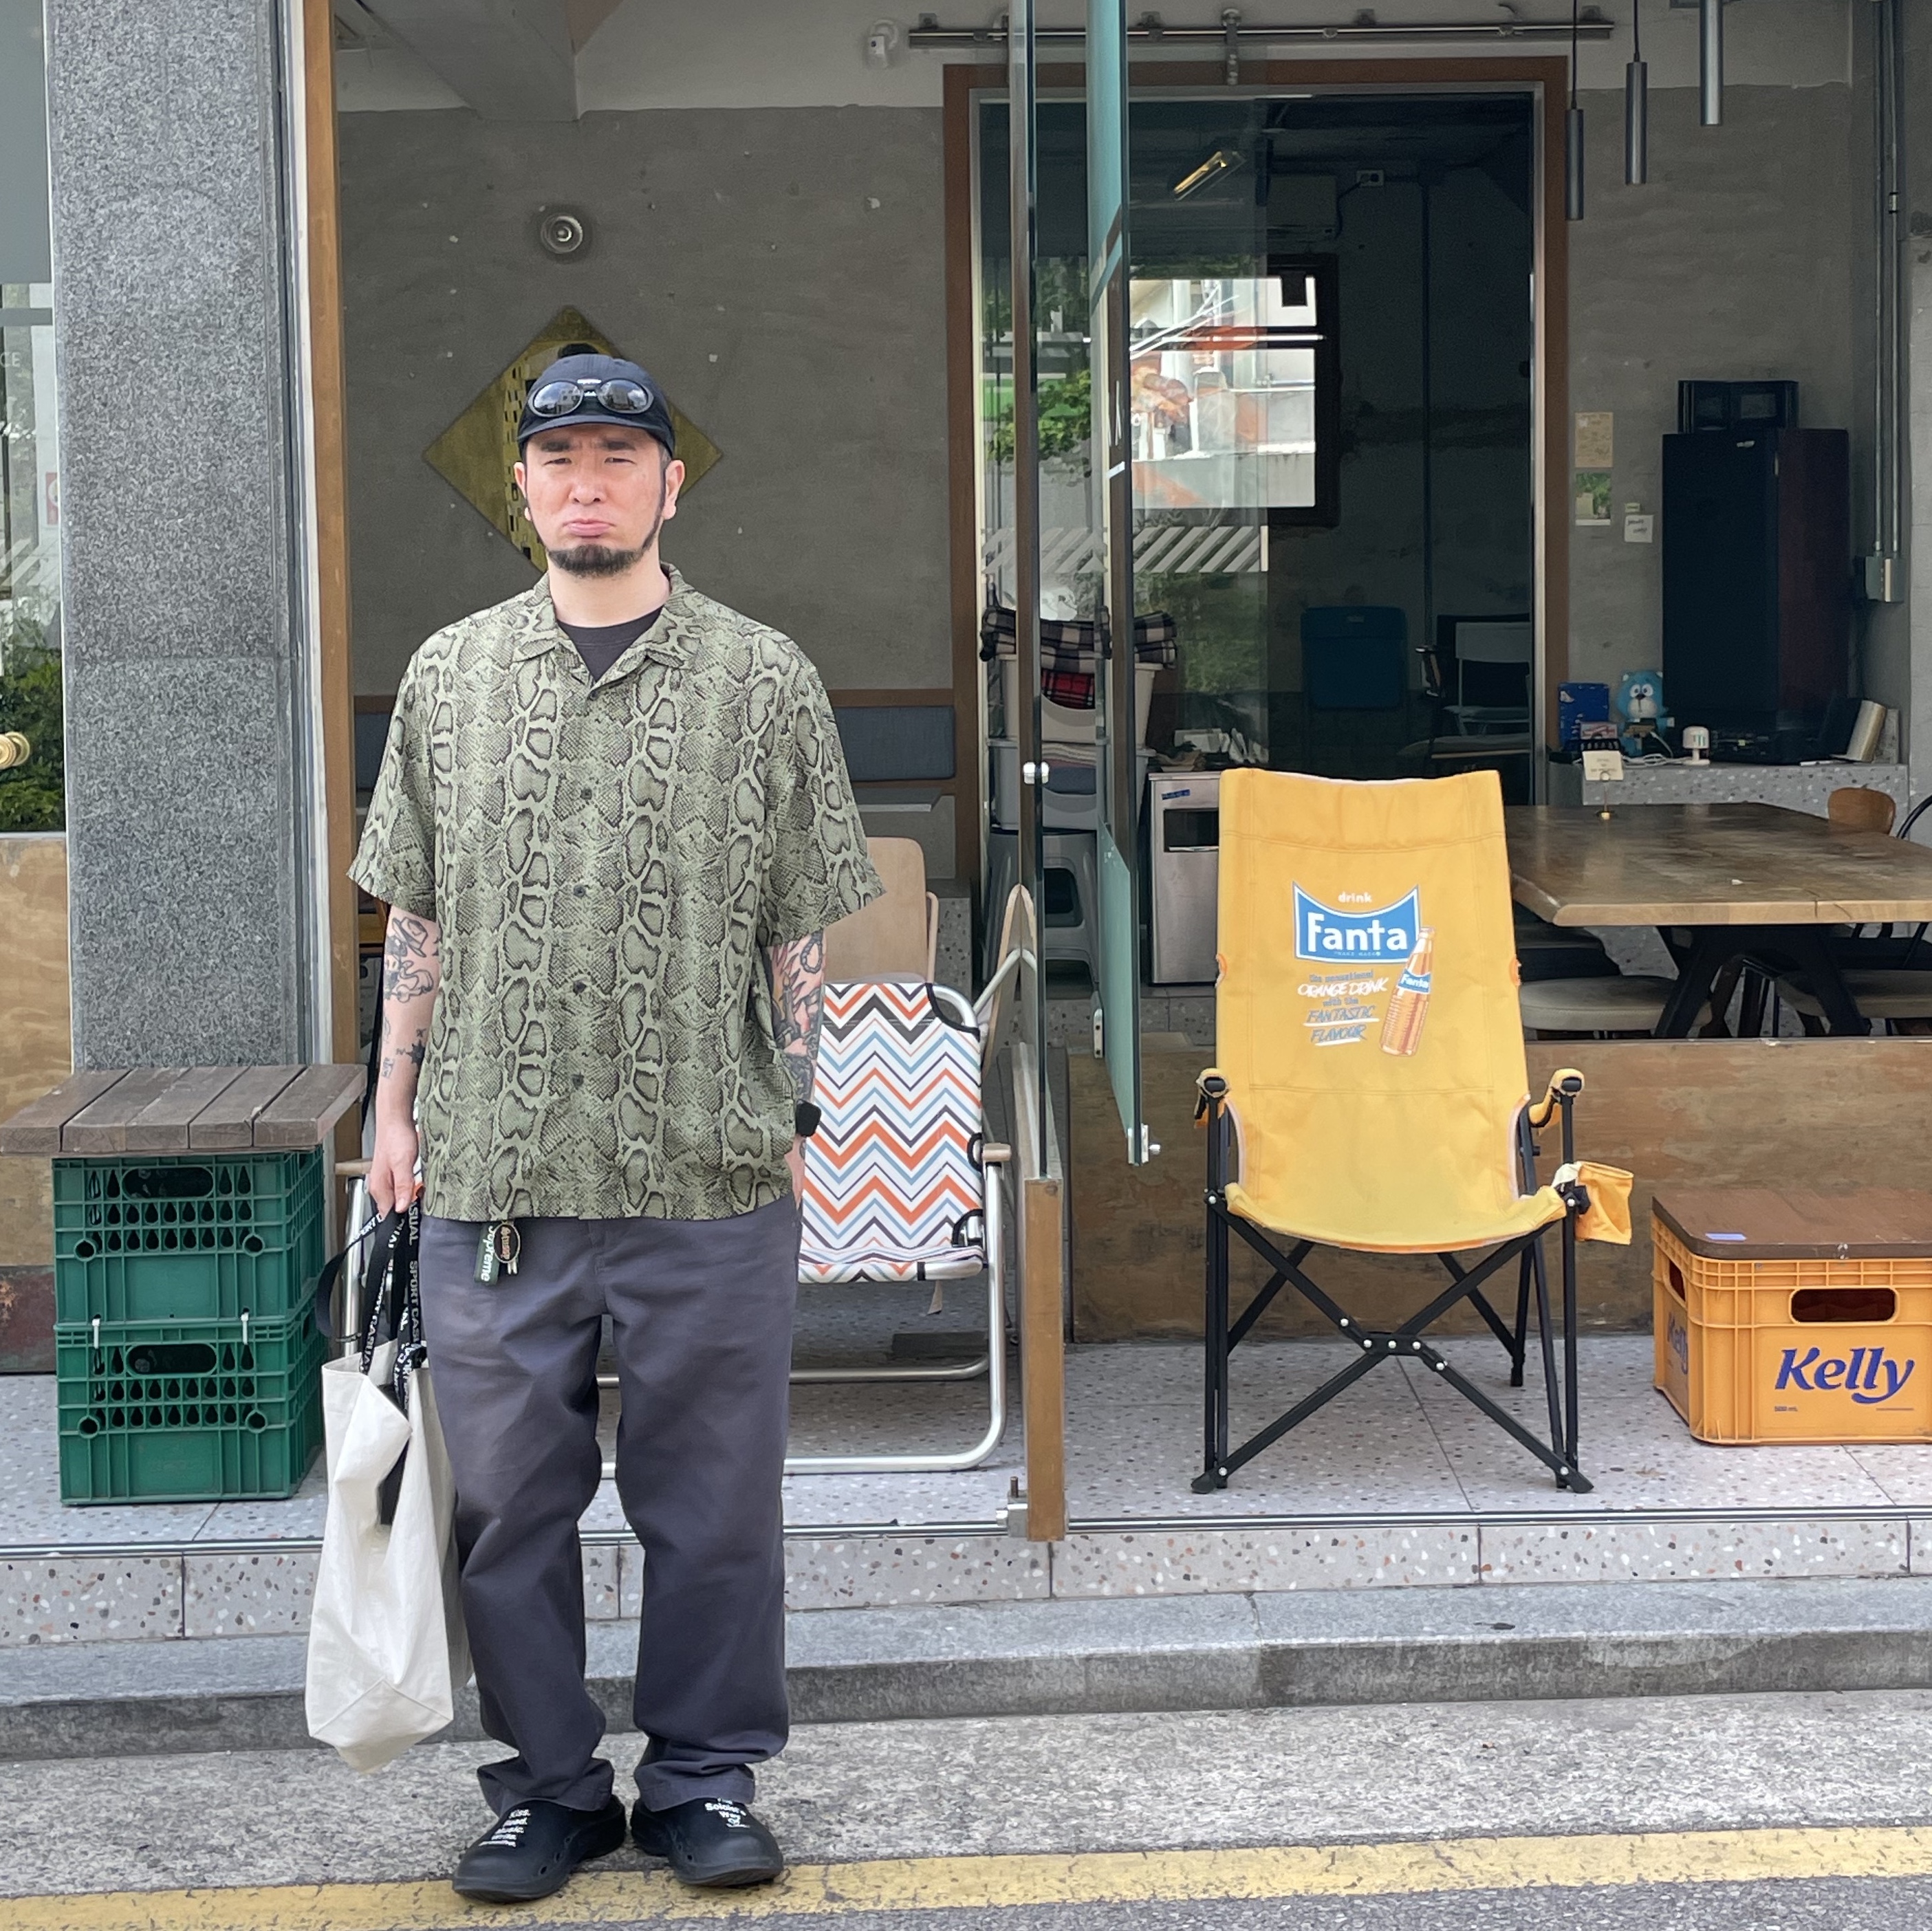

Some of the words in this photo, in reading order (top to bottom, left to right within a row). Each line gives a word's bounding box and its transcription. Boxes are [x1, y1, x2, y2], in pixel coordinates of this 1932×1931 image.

[1338, 891, 1372, 903] drink
[1307, 912, 1407, 952] Fanta
[1297, 981, 1349, 998] ORANGE
[1349, 977, 1389, 996] DRINK
[1401, 974, 1429, 988] Fanta
[481, 1225, 495, 1281] Supreme
[410, 1261, 418, 1305] SPORT
[1774, 1347, 1915, 1404] Kelly
